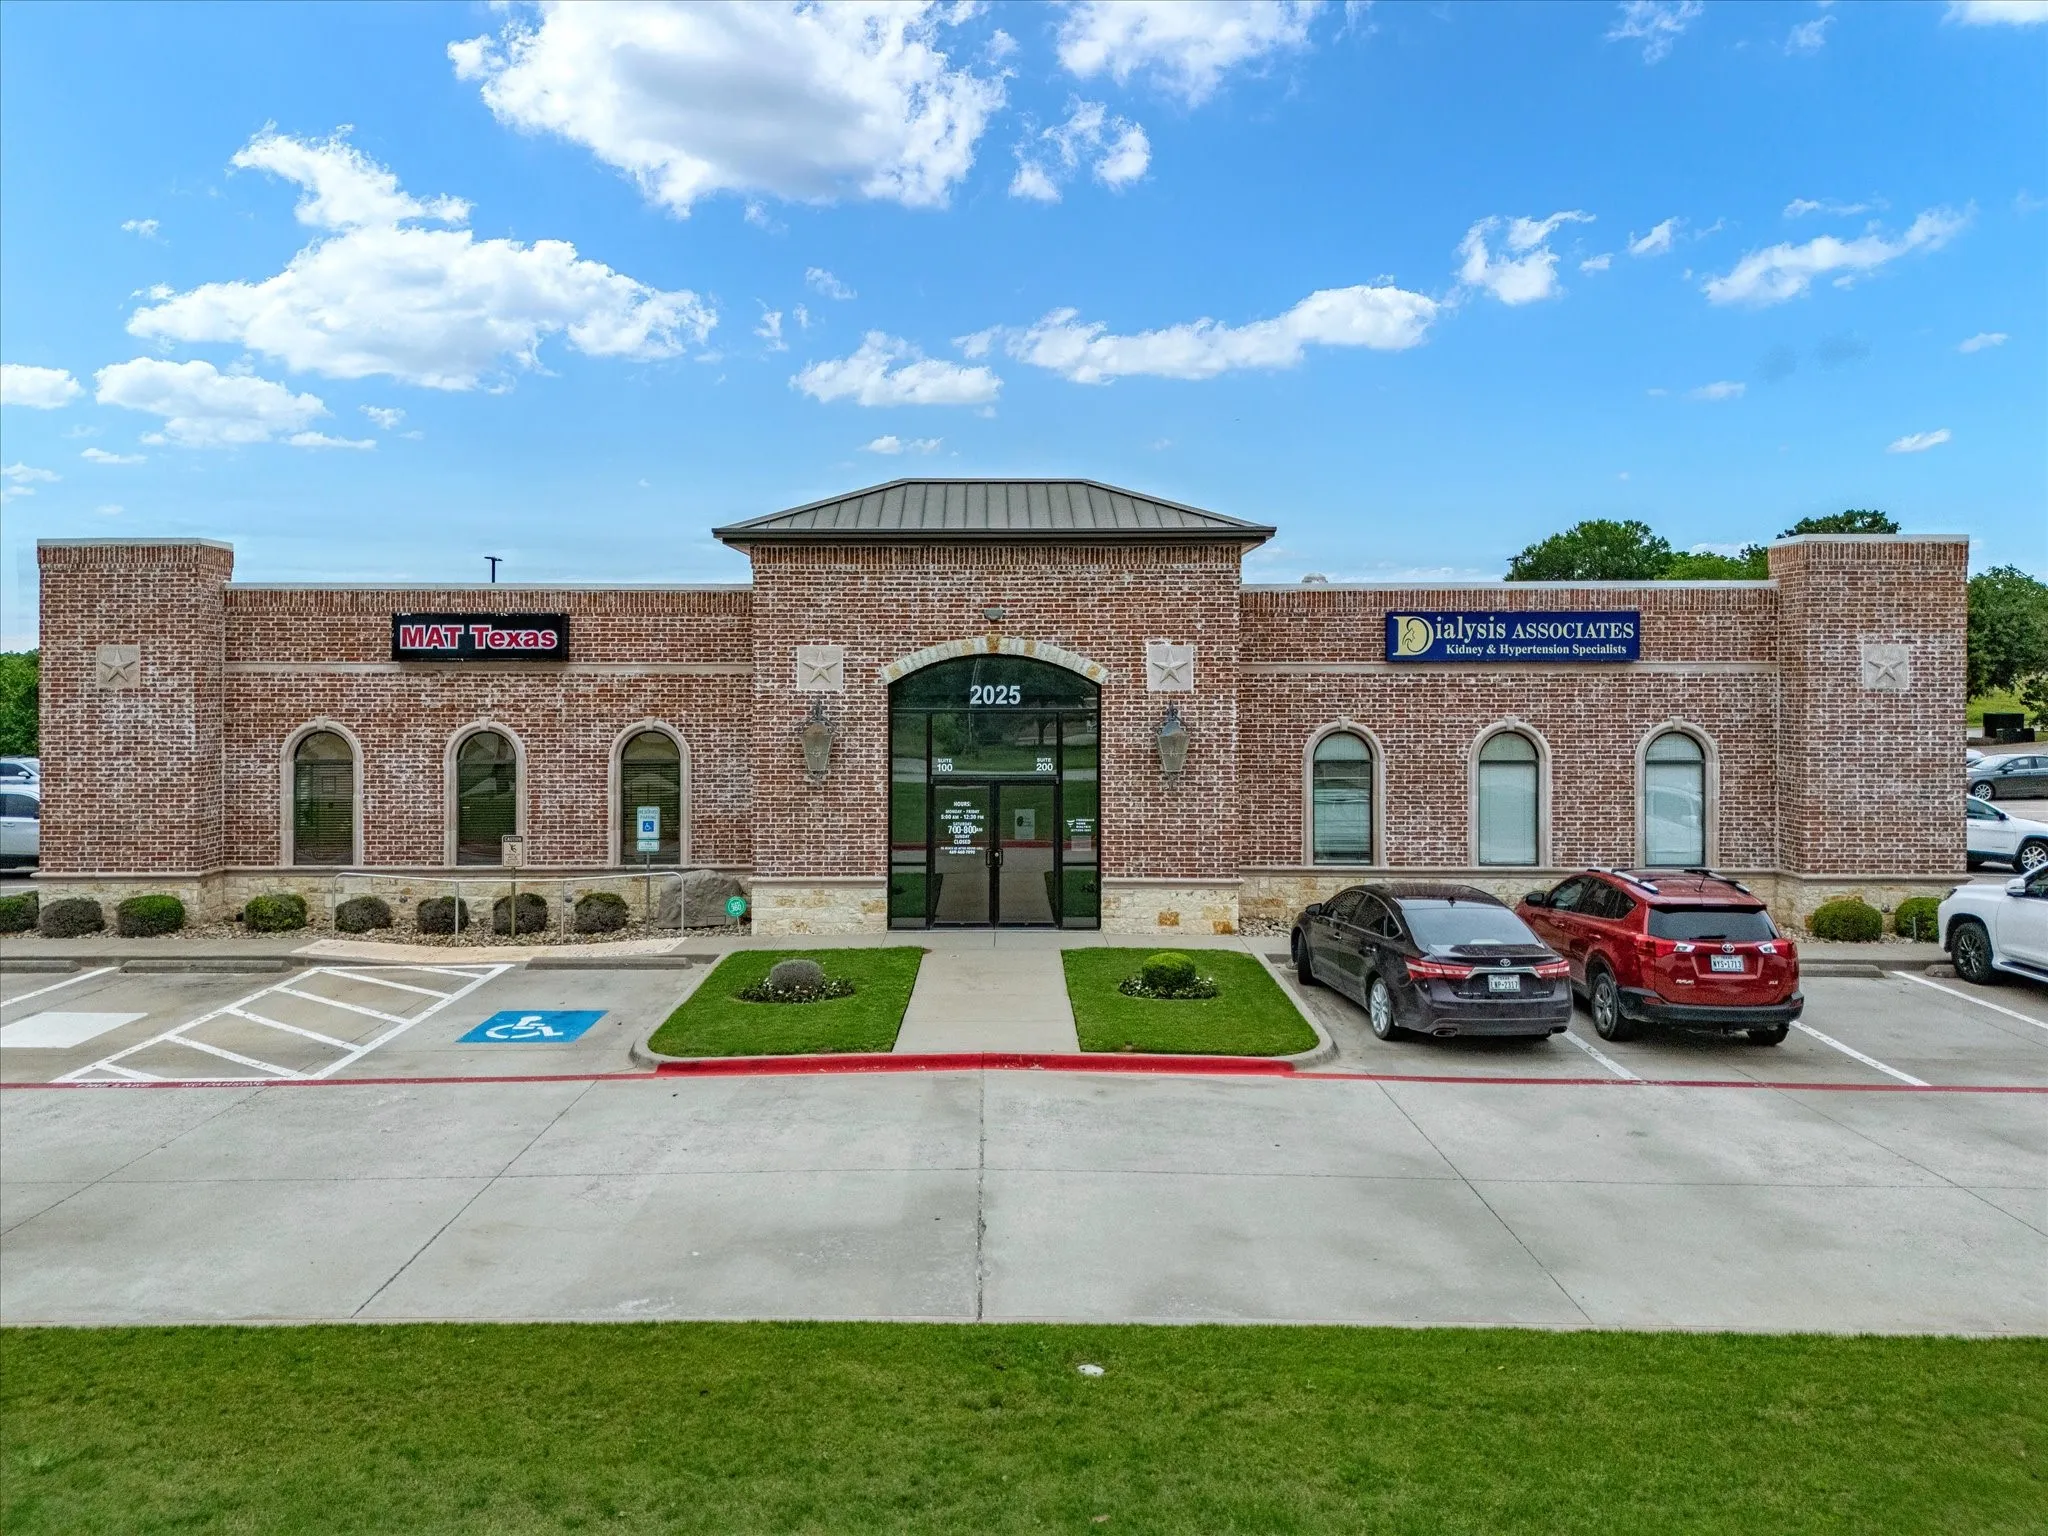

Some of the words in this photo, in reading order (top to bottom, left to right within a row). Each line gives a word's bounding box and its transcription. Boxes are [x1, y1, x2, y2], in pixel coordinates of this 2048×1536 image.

[400, 624, 464, 649] MAT
[469, 624, 558, 649] Texas
[1393, 616, 1506, 656] Dialysis
[1512, 622, 1634, 639] ASSOCIATES
[1446, 644, 1484, 656] Kidney
[1486, 644, 1496, 654] &
[1500, 644, 1569, 656] Hypertension
[1572, 644, 1627, 656] Specialists
[970, 685, 1021, 705] 2025
[937, 763, 953, 772] 100
[1036, 763, 1053, 771] 200
